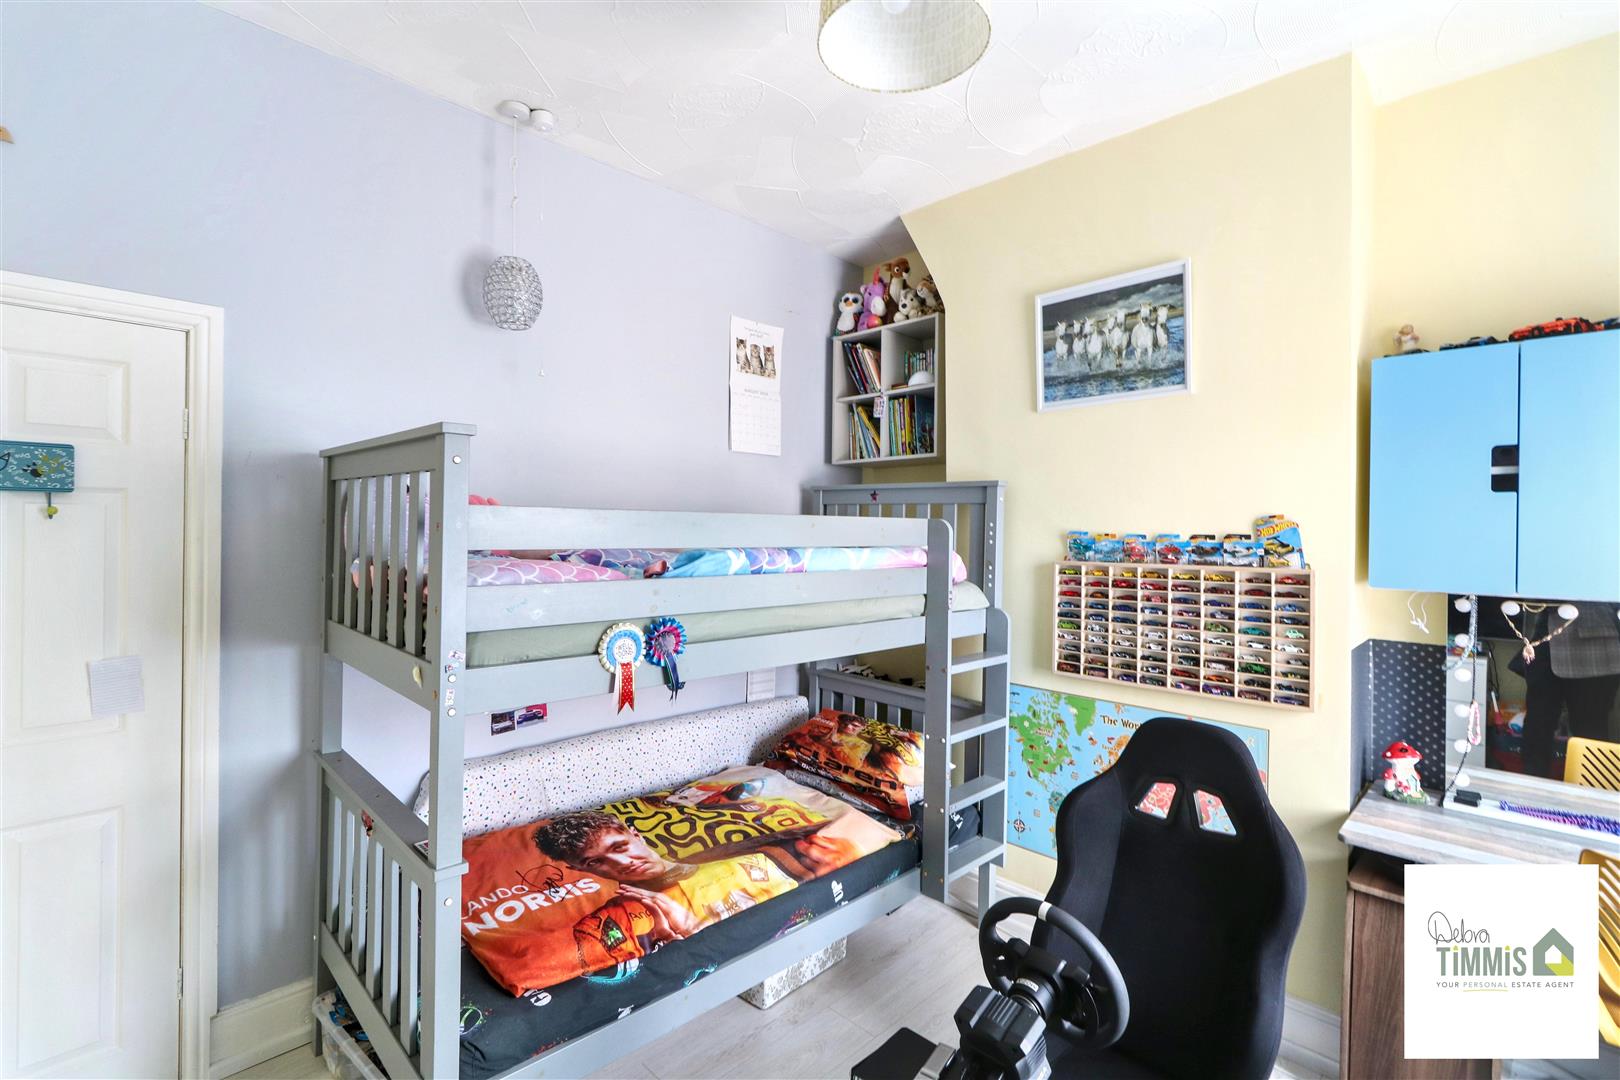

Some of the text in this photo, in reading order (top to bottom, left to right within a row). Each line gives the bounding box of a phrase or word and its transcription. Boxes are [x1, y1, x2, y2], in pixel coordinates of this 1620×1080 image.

[1100, 715, 1141, 730] The Wor
[464, 878, 601, 936] NORRIS
